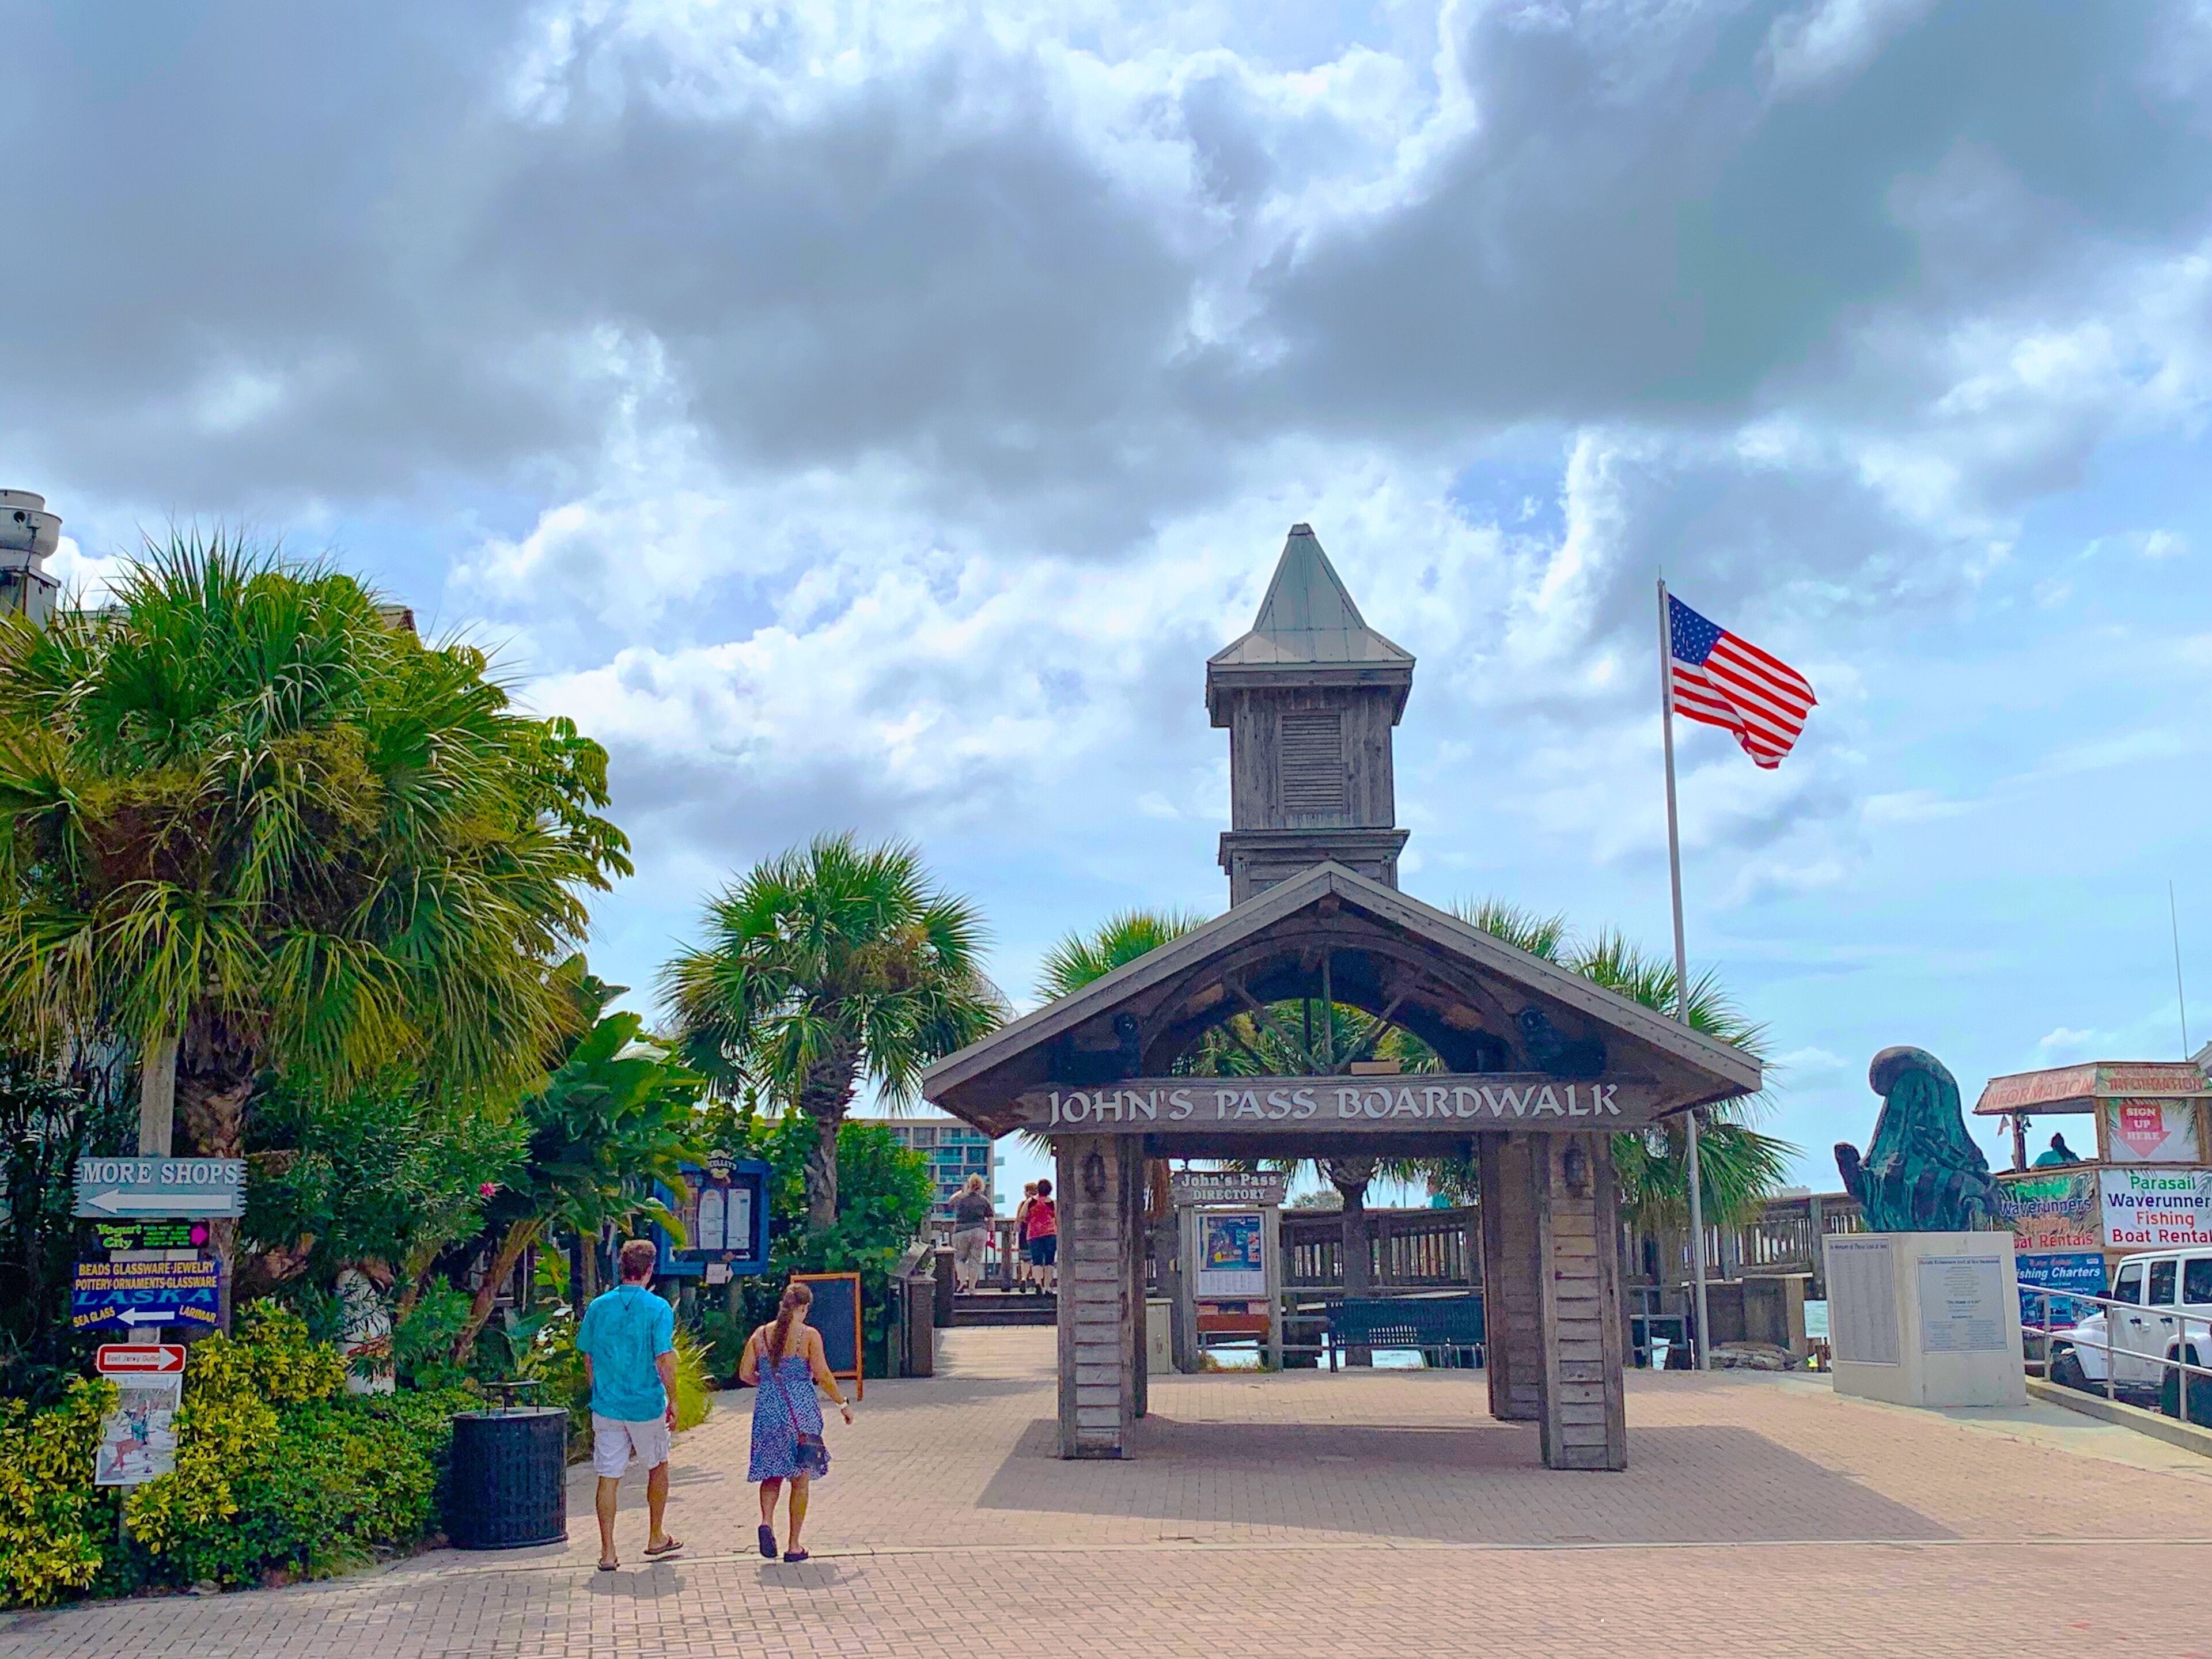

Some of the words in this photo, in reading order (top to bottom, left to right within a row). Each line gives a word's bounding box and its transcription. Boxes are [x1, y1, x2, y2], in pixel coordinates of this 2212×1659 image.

[1983, 1078, 2093, 1107] INFORMATION
[1048, 1089, 1194, 1127] JOHN'S
[1213, 1089, 1317, 1120] PASS
[1333, 1084, 1622, 1119] BOARDWALK
[2126, 1108, 2156, 1116] SIGN
[2133, 1119, 2151, 1128] UP
[2127, 1131, 2160, 1141] HERE
[82, 1162, 153, 1184] MORE
[161, 1163, 238, 1184] SHOPS
[1181, 1173, 1233, 1187] John's
[1240, 1173, 1277, 1187] Pass
[2130, 1176, 2196, 1190] Parasail
[1192, 1189, 1266, 1201] DIRECTORY
[2108, 1193, 2211, 1208] Waverunner
[2000, 1198, 2092, 1217] Waverunners
[2136, 1210, 2195, 1229] Fishing
[95, 1224, 142, 1237] Yogurt
[2112, 1229, 2152, 1243] Boat
[102, 1237, 133, 1250] City
[2014, 1236, 2033, 1249] oat
[2040, 1233, 2093, 1248] Rentals
[78, 1263, 111, 1276] BEADS
[112, 1262, 170, 1275] GLASSWARE
[172, 1261, 215, 1274] JEWELRY
[2017, 1267, 2048, 1281] ishing
[2051, 1267, 2101, 1278] Charters
[75, 1278, 111, 1291] POTTERY
[113, 1278, 165, 1290] ORNAMENTS
[166, 1276, 217, 1288] GLASSWARE
[75, 1289, 213, 1305] LASKA
[73, 1313, 89, 1327] SEA
[90, 1306, 116, 1323] GLASS
[179, 1305, 217, 1324] LARIMAR
